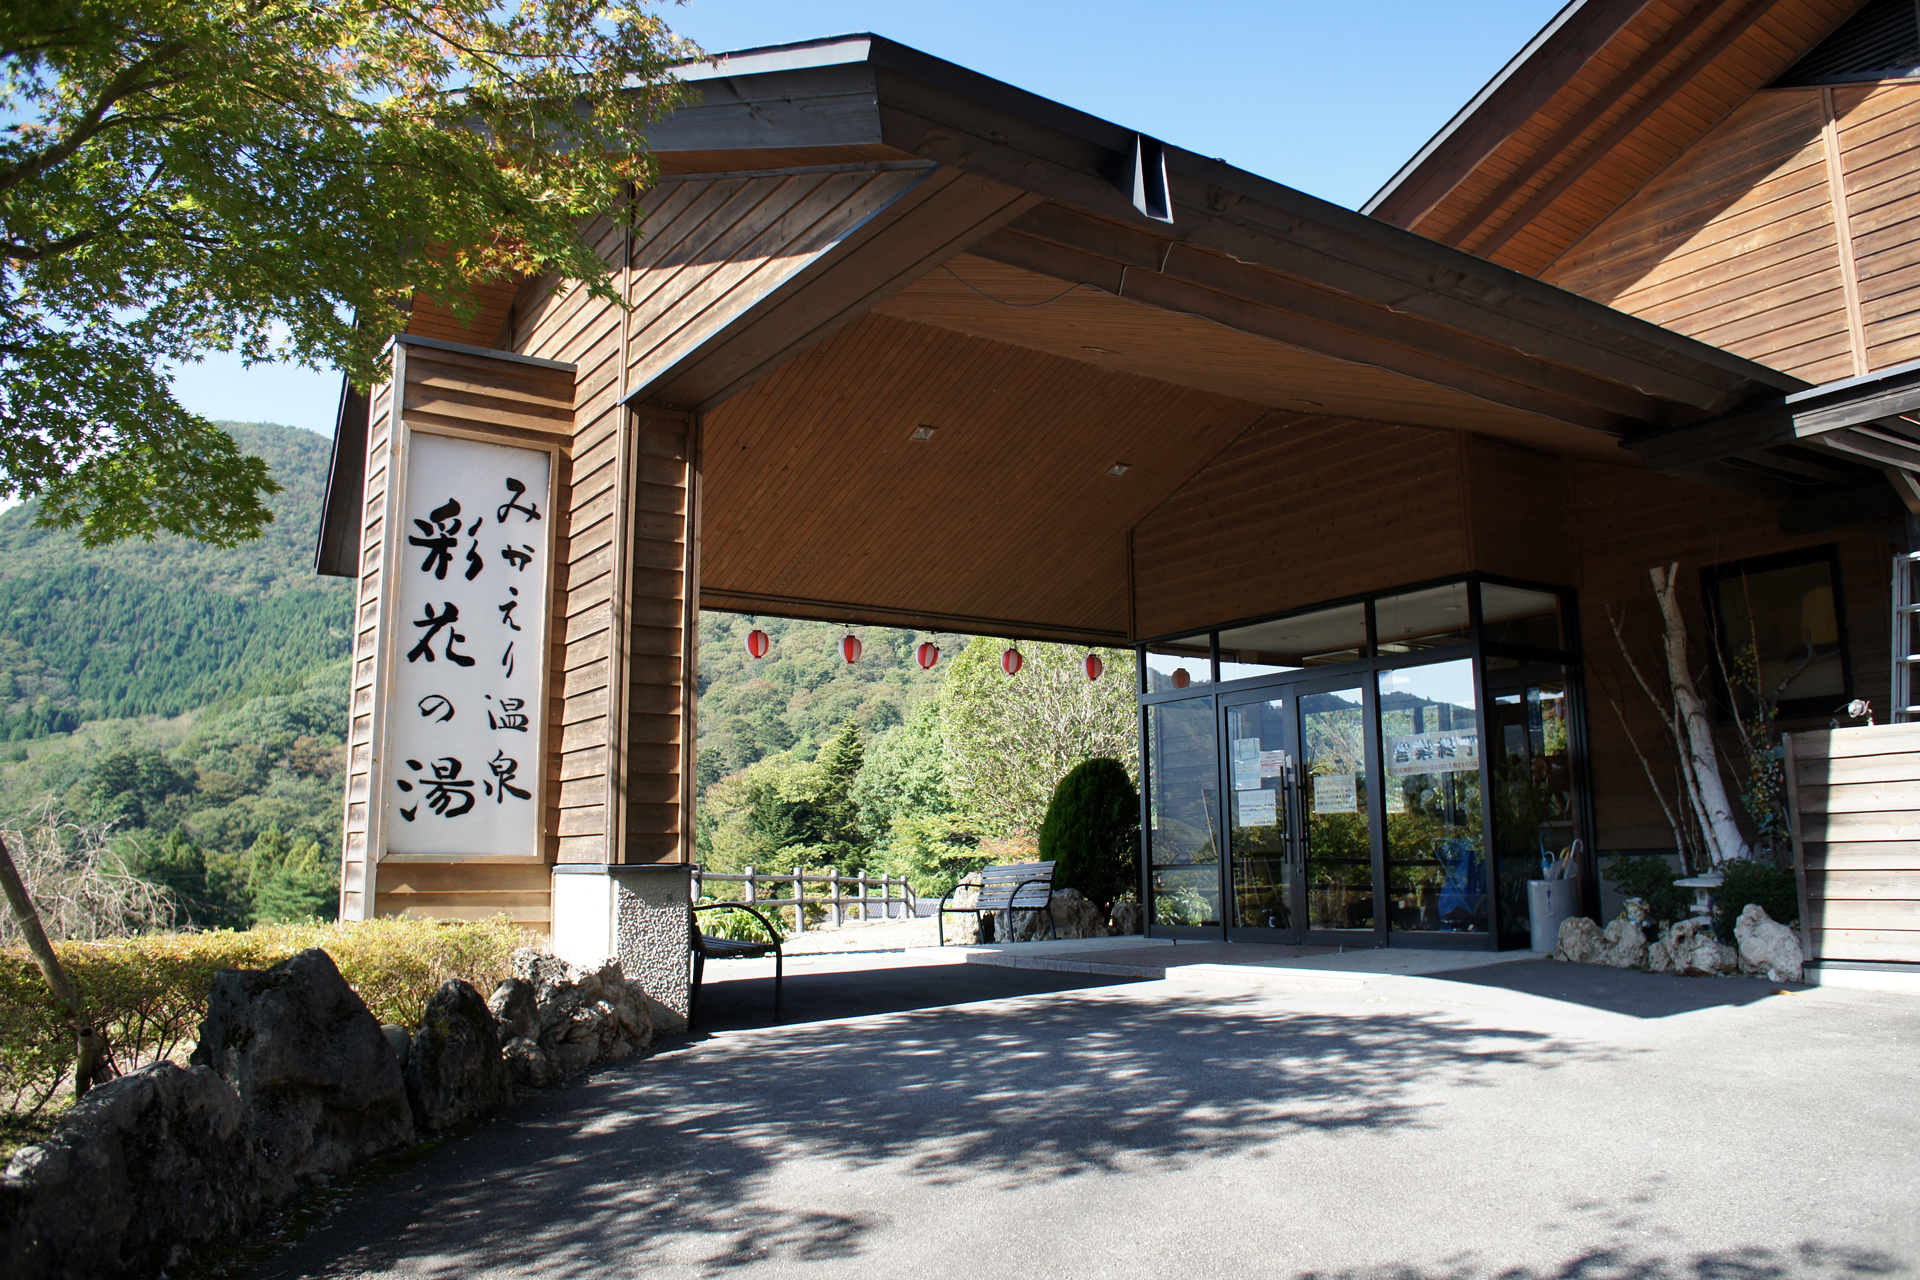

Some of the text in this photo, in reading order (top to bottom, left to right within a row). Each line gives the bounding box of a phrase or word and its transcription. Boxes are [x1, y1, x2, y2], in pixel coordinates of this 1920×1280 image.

[397, 497, 484, 823] 彩花の湯
[484, 477, 542, 804] みかえり温泉
